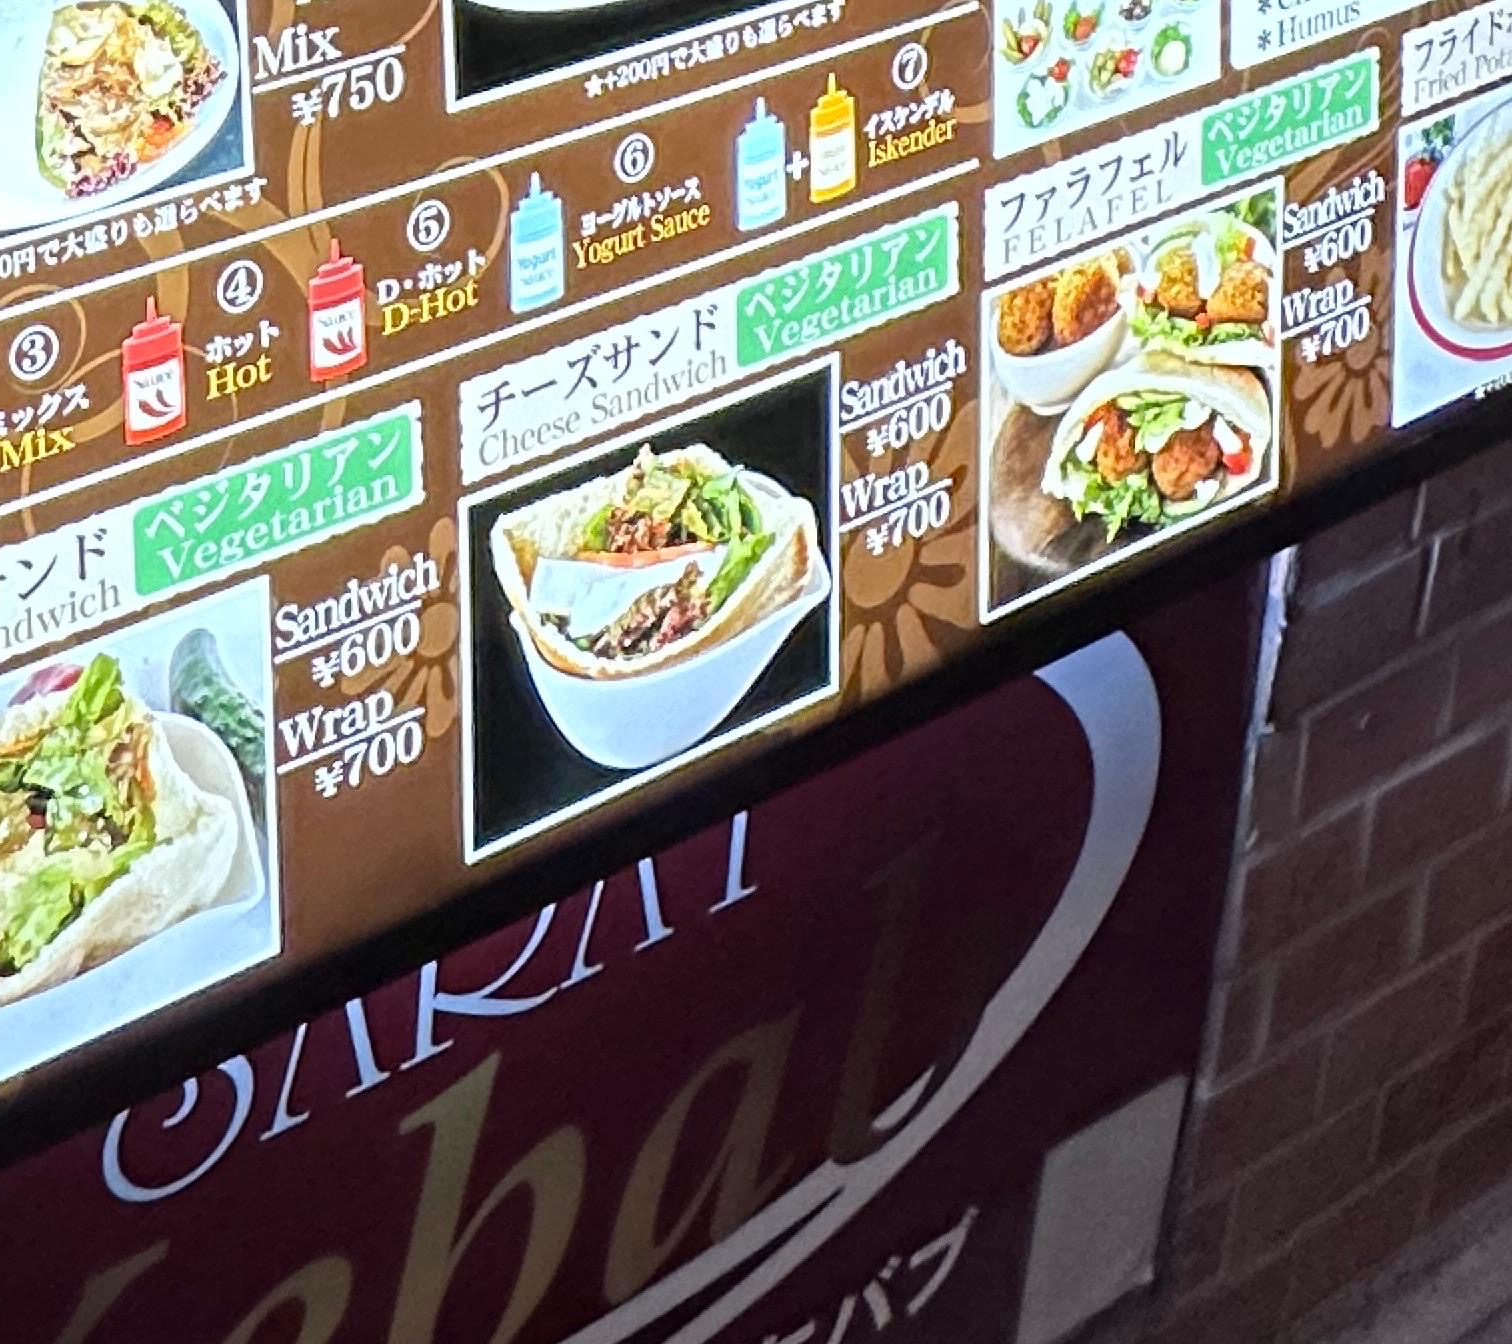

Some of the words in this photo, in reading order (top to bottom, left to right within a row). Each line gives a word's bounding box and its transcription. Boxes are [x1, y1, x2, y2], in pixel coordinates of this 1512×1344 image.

[254, 22, 343, 80] Mix
[1277, 0, 1361, 47] Humus
[292, 57, 405, 128] ¥750
[1205, 61, 1374, 147] ベジタリアン
[1414, 61, 1467, 104] Fried
[867, 118, 957, 169] Iskender
[1215, 102, 1364, 182] Vegetarian
[999, 127, 1189, 234] ファラフェル
[1282, 168, 1386, 236] Sandwich
[572, 220, 647, 270] Yogurt
[650, 202, 711, 244] Sauce
[1002, 178, 1174, 265] FELAFEL
[1303, 217, 1373, 275] ¥600
[743, 221, 942, 321] ベジタリアン
[1282, 274, 1355, 331] Wrap
[204, 319, 281, 363] ホット
[381, 279, 480, 337] D-Hot
[754, 264, 939, 355] Vegetarian
[1299, 307, 1372, 366] ¥700
[205, 351, 273, 402] Hot
[477, 303, 720, 434] チーズサンド
[840, 339, 967, 417] Sandwich
[479, 412, 581, 469] Cheese
[590, 350, 727, 425] Sandwich
[865, 393, 952, 458] ¥600
[143, 426, 404, 545] ベジタリアン
[841, 462, 929, 520] Wrap
[154, 473, 401, 583] Vegetarian
[865, 490, 952, 557] ¥700
[275, 553, 441, 649] Sandwich
[311, 615, 421, 691] ¥600
[278, 689, 393, 757] Wrap
[313, 721, 424, 800] ¥700
